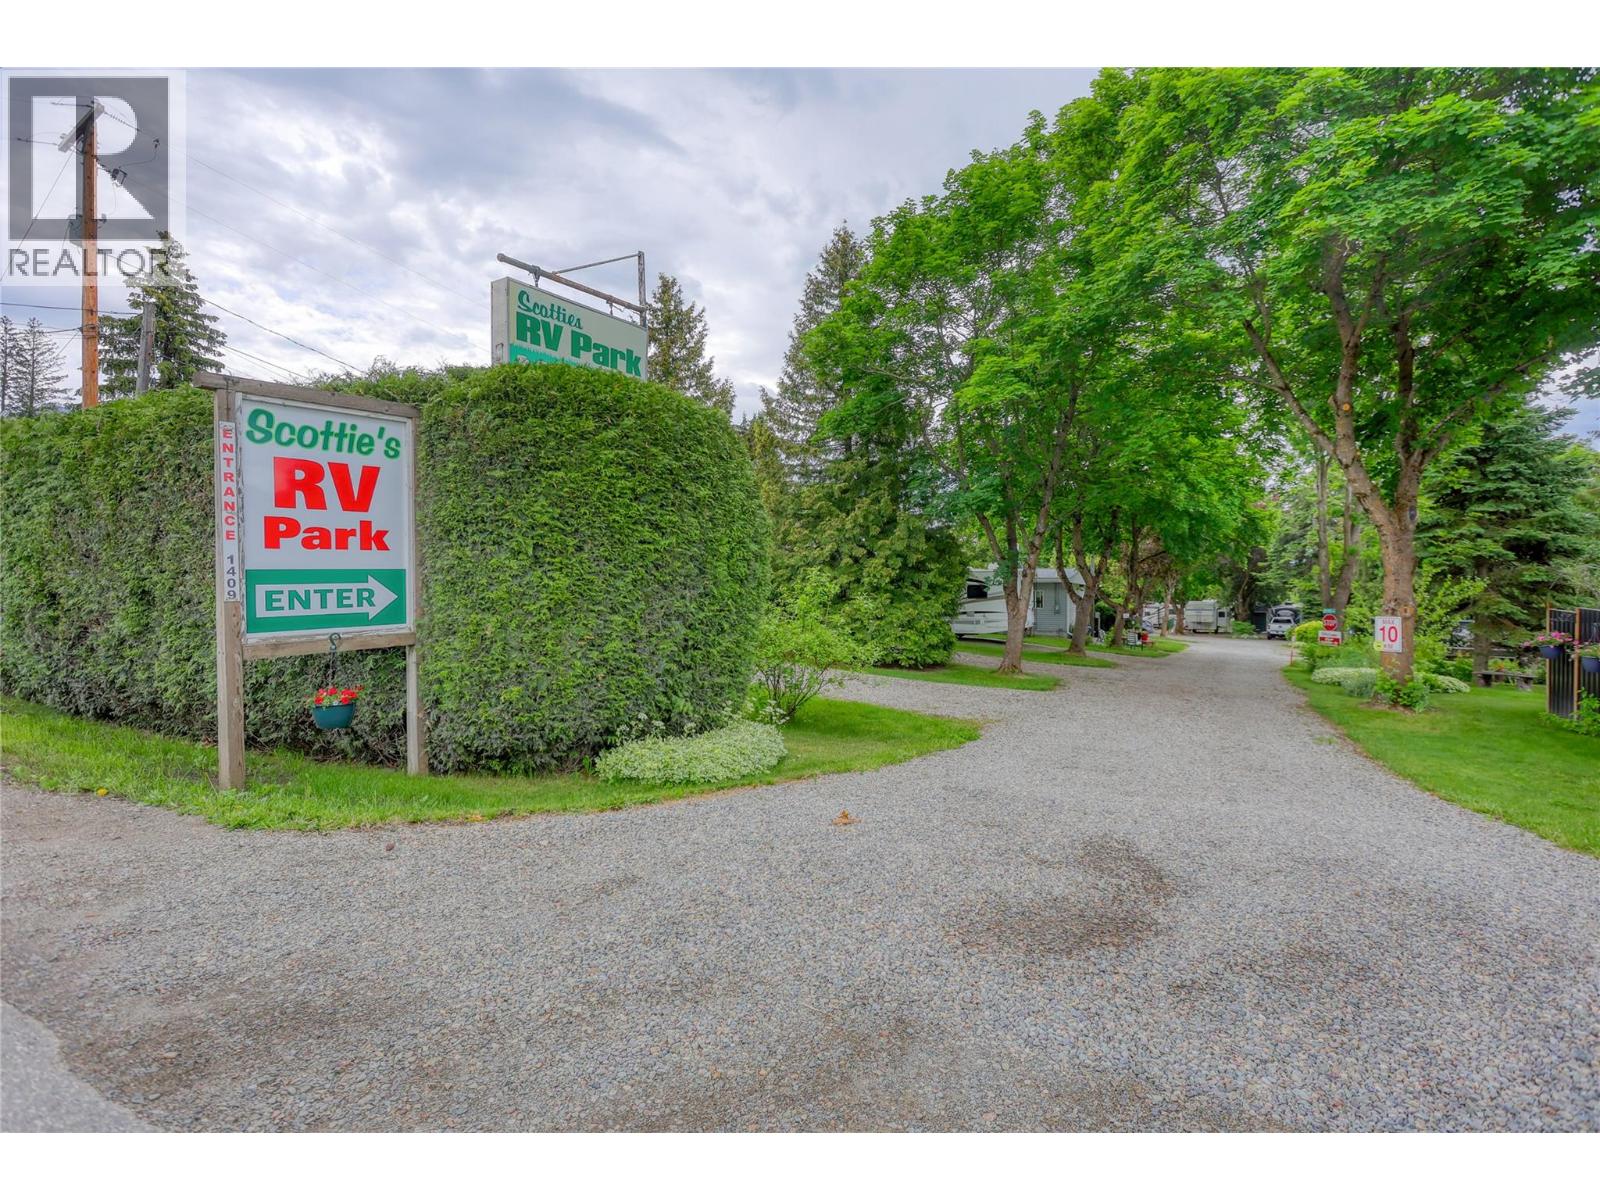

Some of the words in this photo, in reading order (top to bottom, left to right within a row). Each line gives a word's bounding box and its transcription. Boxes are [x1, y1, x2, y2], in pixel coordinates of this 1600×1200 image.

[517, 290, 583, 330] Scotties
[516, 311, 563, 352] RV
[571, 330, 641, 377] Park
[246, 408, 401, 460] Scottie's
[222, 426, 236, 541] ENTRANCE
[273, 456, 381, 512] RV
[263, 516, 390, 551] Park
[226, 555, 237, 600] 1409
[265, 587, 376, 612] ENTER
[1379, 625, 1399, 643] 10
